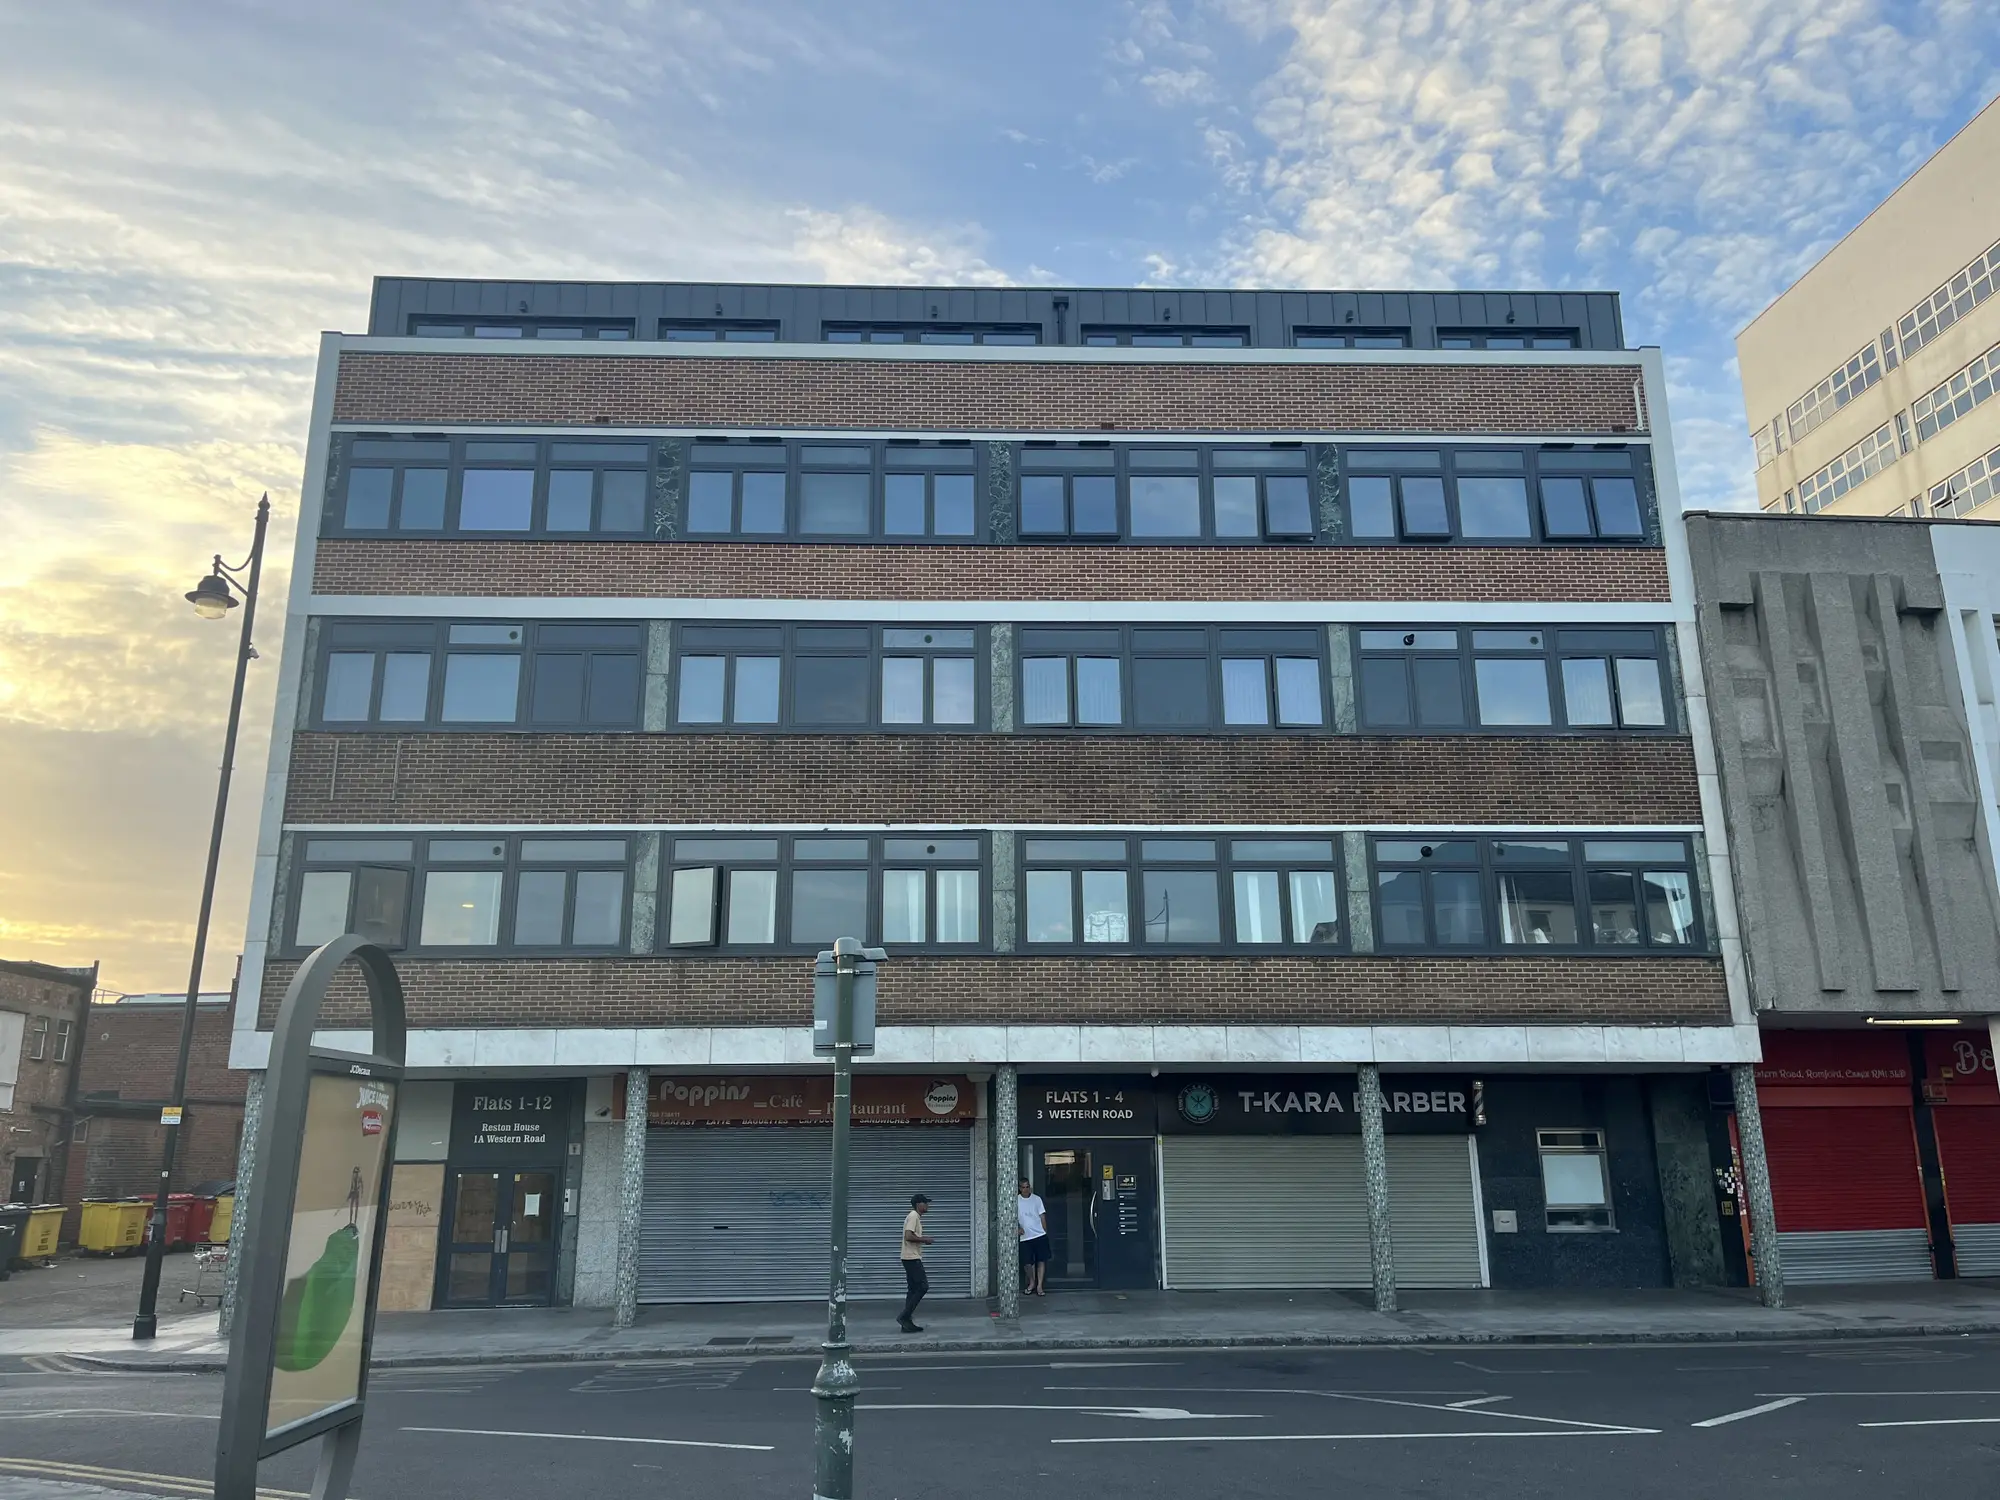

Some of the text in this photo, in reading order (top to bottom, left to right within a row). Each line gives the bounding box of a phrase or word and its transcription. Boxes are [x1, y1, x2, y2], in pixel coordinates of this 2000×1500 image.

[660, 1080, 906, 1115] Poppins Café Rtaurant
[928, 1094, 956, 1103] Poppins
[1046, 1091, 1088, 1103] FLATS
[1092, 1091, 1099, 1103] 1
[1114, 1091, 1124, 1103] 4
[473, 1096, 552, 1110] Flats 1-12
[1238, 1092, 1344, 1113] T-KARA
[1037, 1110, 1133, 1119] 3 WESTERN ROAD
[482, 1123, 540, 1132] Reston House
[474, 1134, 546, 1143] 1A Western Road
